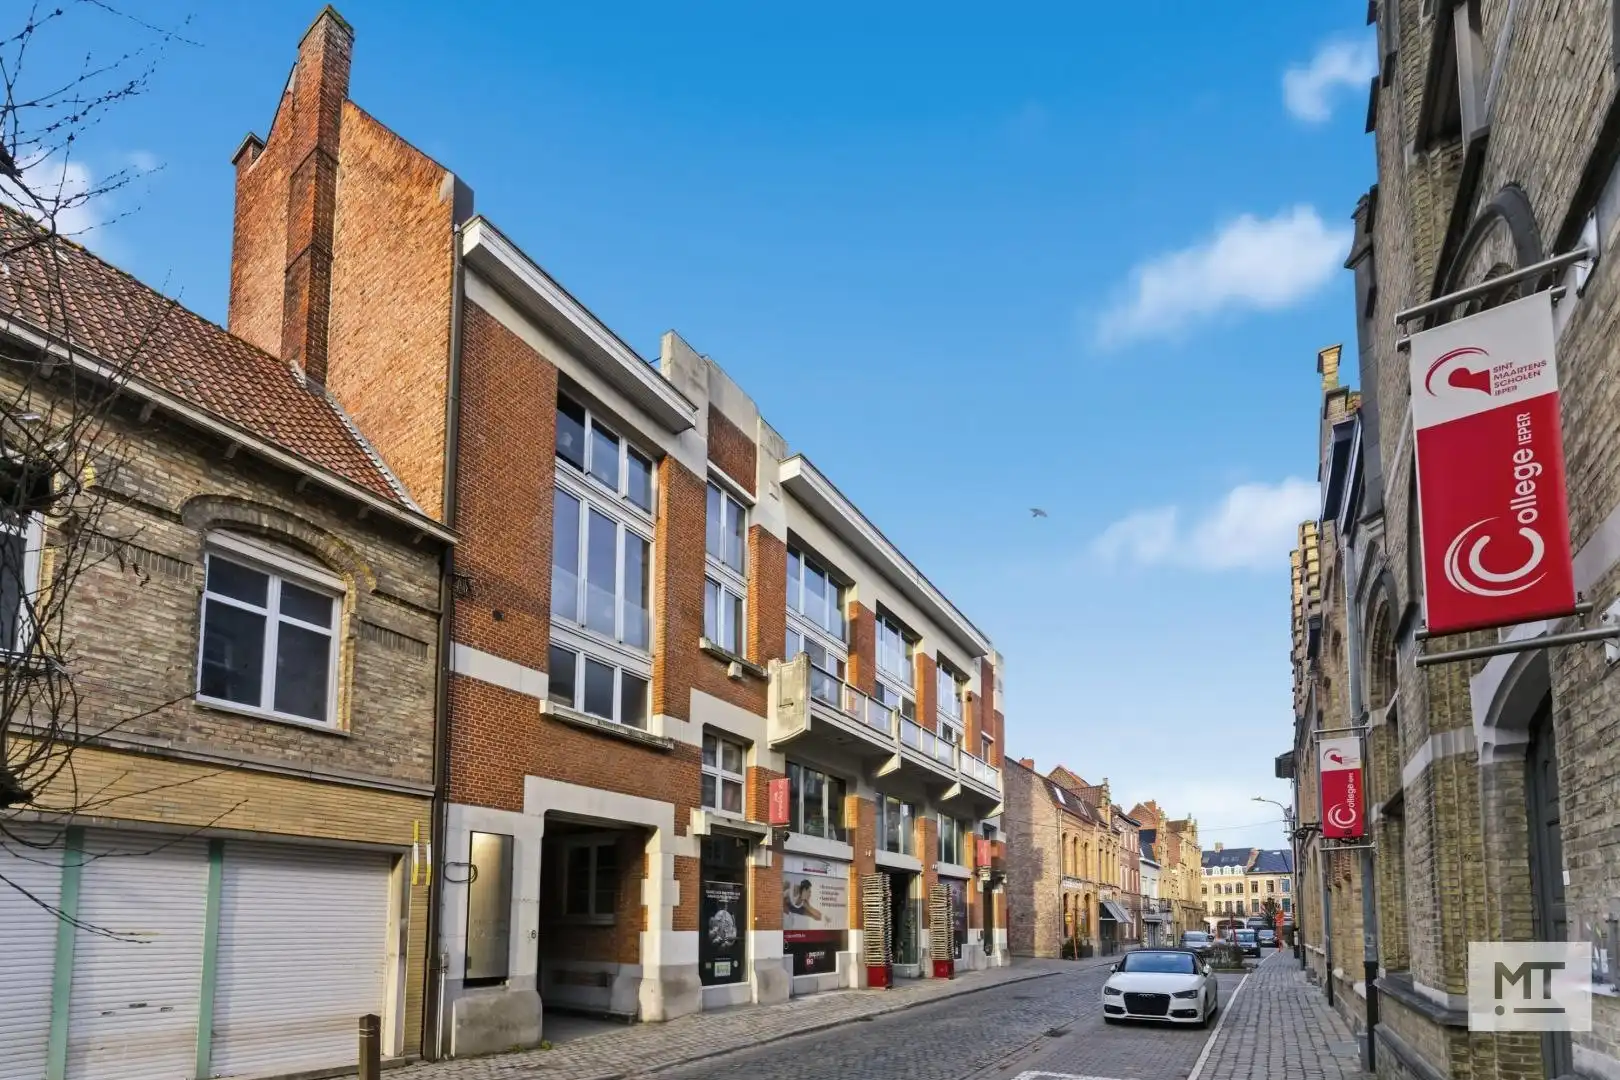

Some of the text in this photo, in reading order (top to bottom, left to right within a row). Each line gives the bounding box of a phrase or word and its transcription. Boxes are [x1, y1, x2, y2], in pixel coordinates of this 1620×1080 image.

[1493, 362, 1513, 373] SINT
[1494, 360, 1547, 380] MAARTENS
[1494, 371, 1541, 388] SCHOLEN
[1469, 412, 1545, 582] College IEPER
[1334, 783, 1357, 825] College
